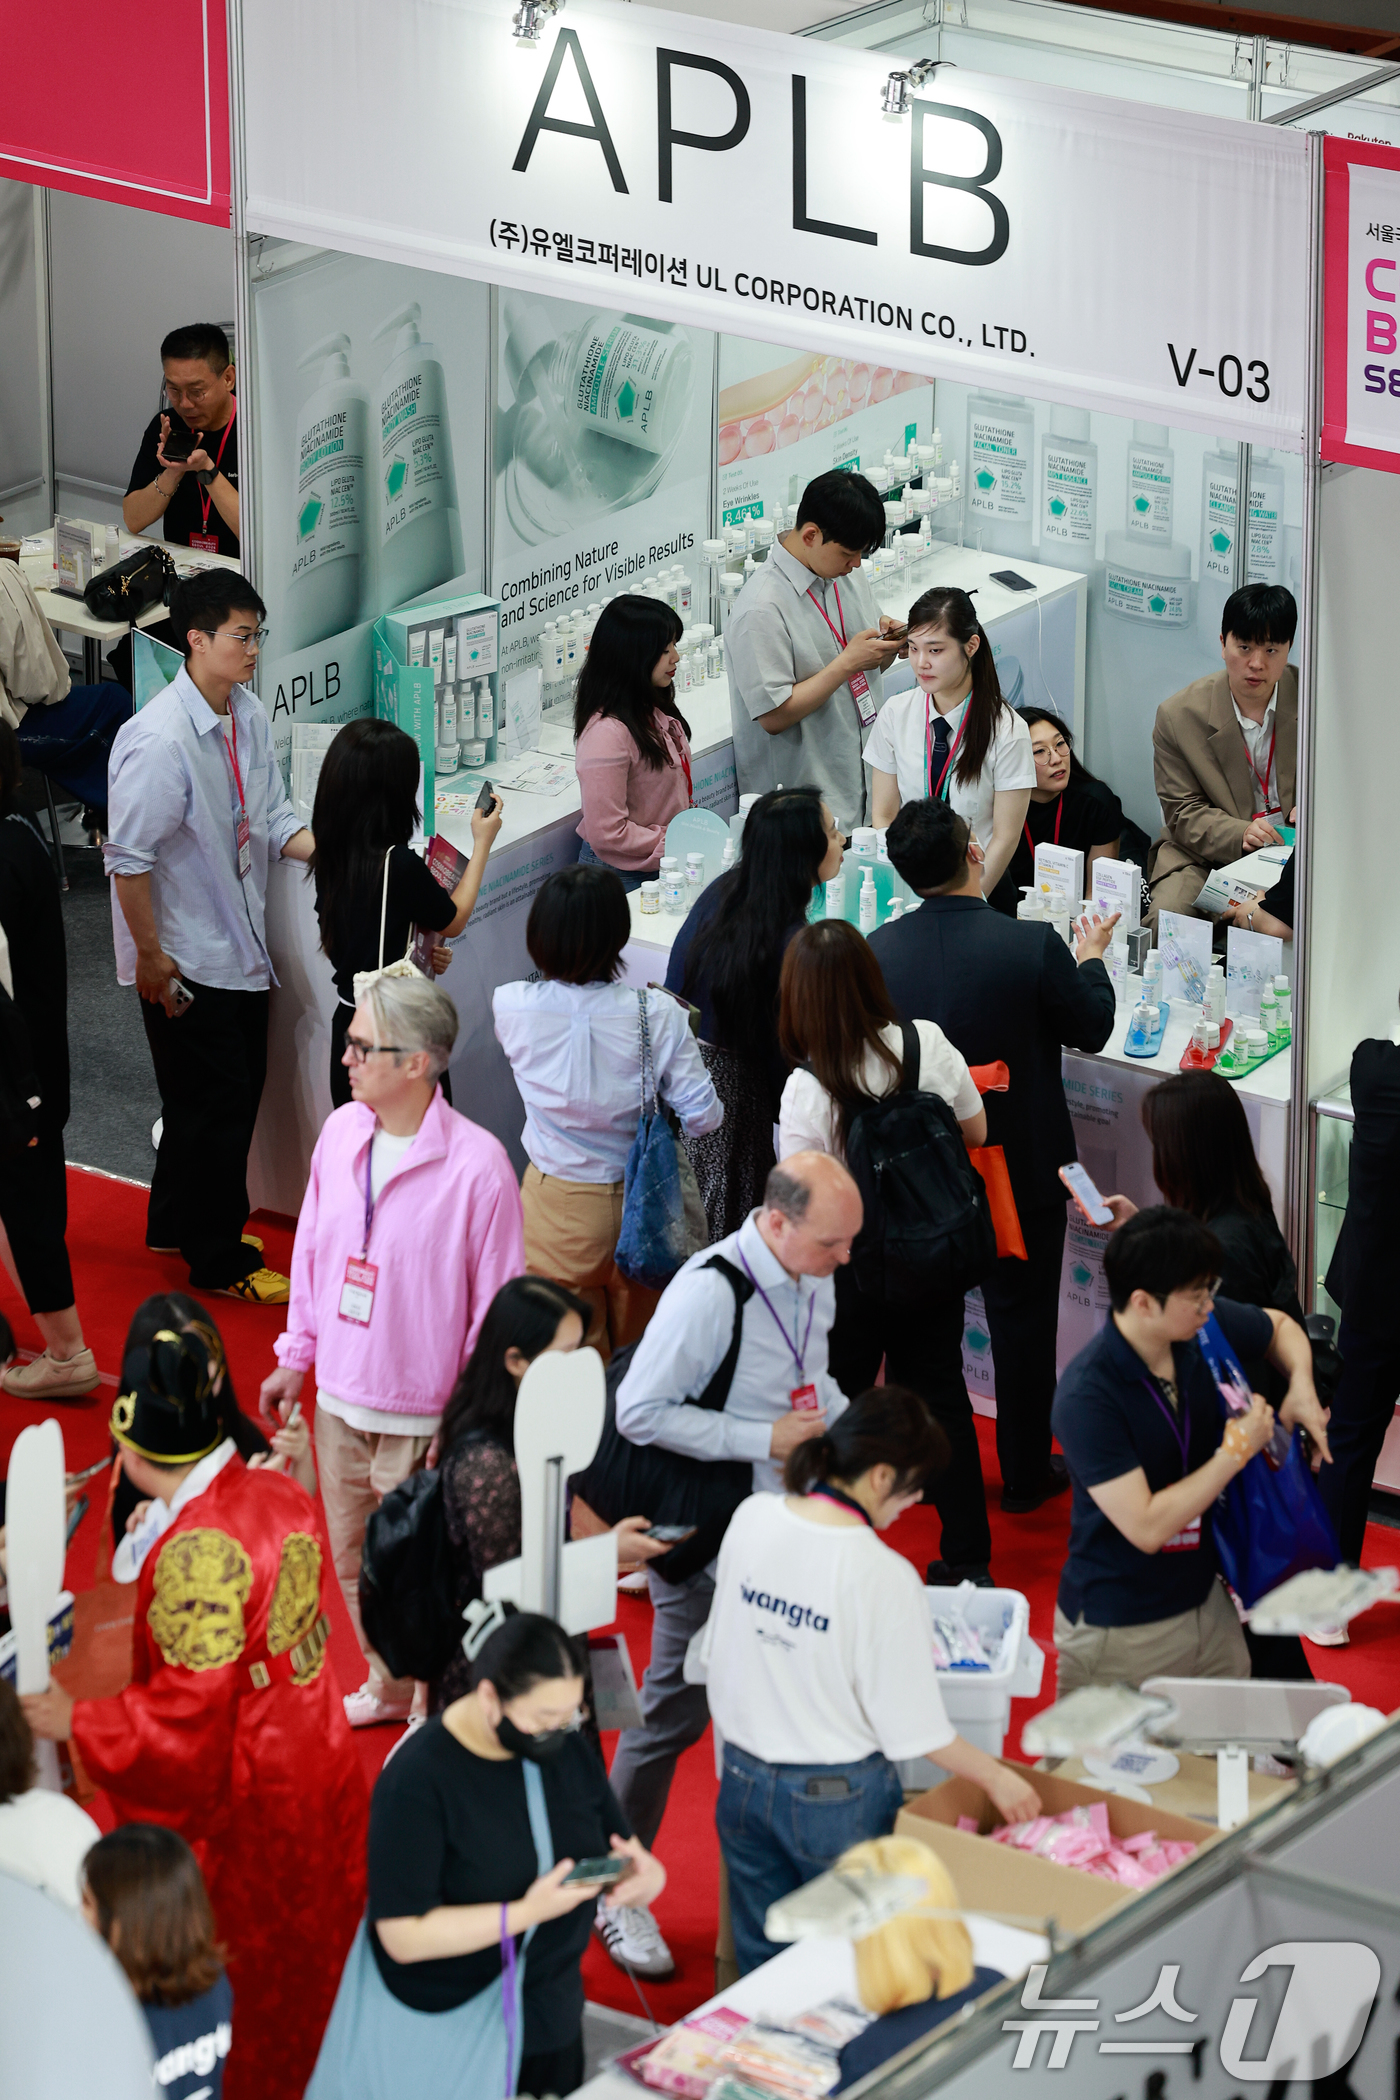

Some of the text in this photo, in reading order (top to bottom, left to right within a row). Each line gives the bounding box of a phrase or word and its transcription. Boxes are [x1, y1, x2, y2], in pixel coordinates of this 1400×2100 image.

[512, 27, 1010, 266] APLB
[489, 218, 1035, 357] (주)유엘코퍼레이션 UL CORPORATION CO., LTD.
[577, 336, 600, 409] GLUTATHIONE
[583, 341, 604, 412] NIACINAMIDE
[1167, 343, 1270, 403] V-03
[381, 374, 422, 414] GLUTATHIONE
[381, 388, 420, 428] NIACINAMIDE
[641, 390, 653, 433] APLB
[300, 426, 344, 461] NIACINAMIDE
[301, 412, 347, 447] GLUTATHIONE
[974, 423, 1015, 438] GLUTATHIONE
[974, 432, 1013, 446] NIACINAMIDE
[1047, 454, 1087, 469] GLUTATHIONE
[1047, 462, 1085, 476] NIACINAMIDE
[722, 492, 760, 509] Eye Wrinkles
[972, 498, 994, 510] APLB
[386, 507, 406, 535] APLB
[1046, 525, 1068, 537] APLB
[1130, 519, 1149, 530] APLB
[292, 549, 316, 576] APLB
[501, 540, 619, 602] Combining Nature
[1207, 561, 1230, 575] APLB
[501, 533, 694, 628] and Science for Visible Results
[272, 661, 341, 723] APLB
[413, 682, 422, 730] WITH APLB
[488, 865, 531, 893] NIACINAMIDE
[531, 852, 555, 872] SERIES
[1089, 1085, 1123, 1104] SERIES
[1067, 1291, 1091, 1307] APLB
